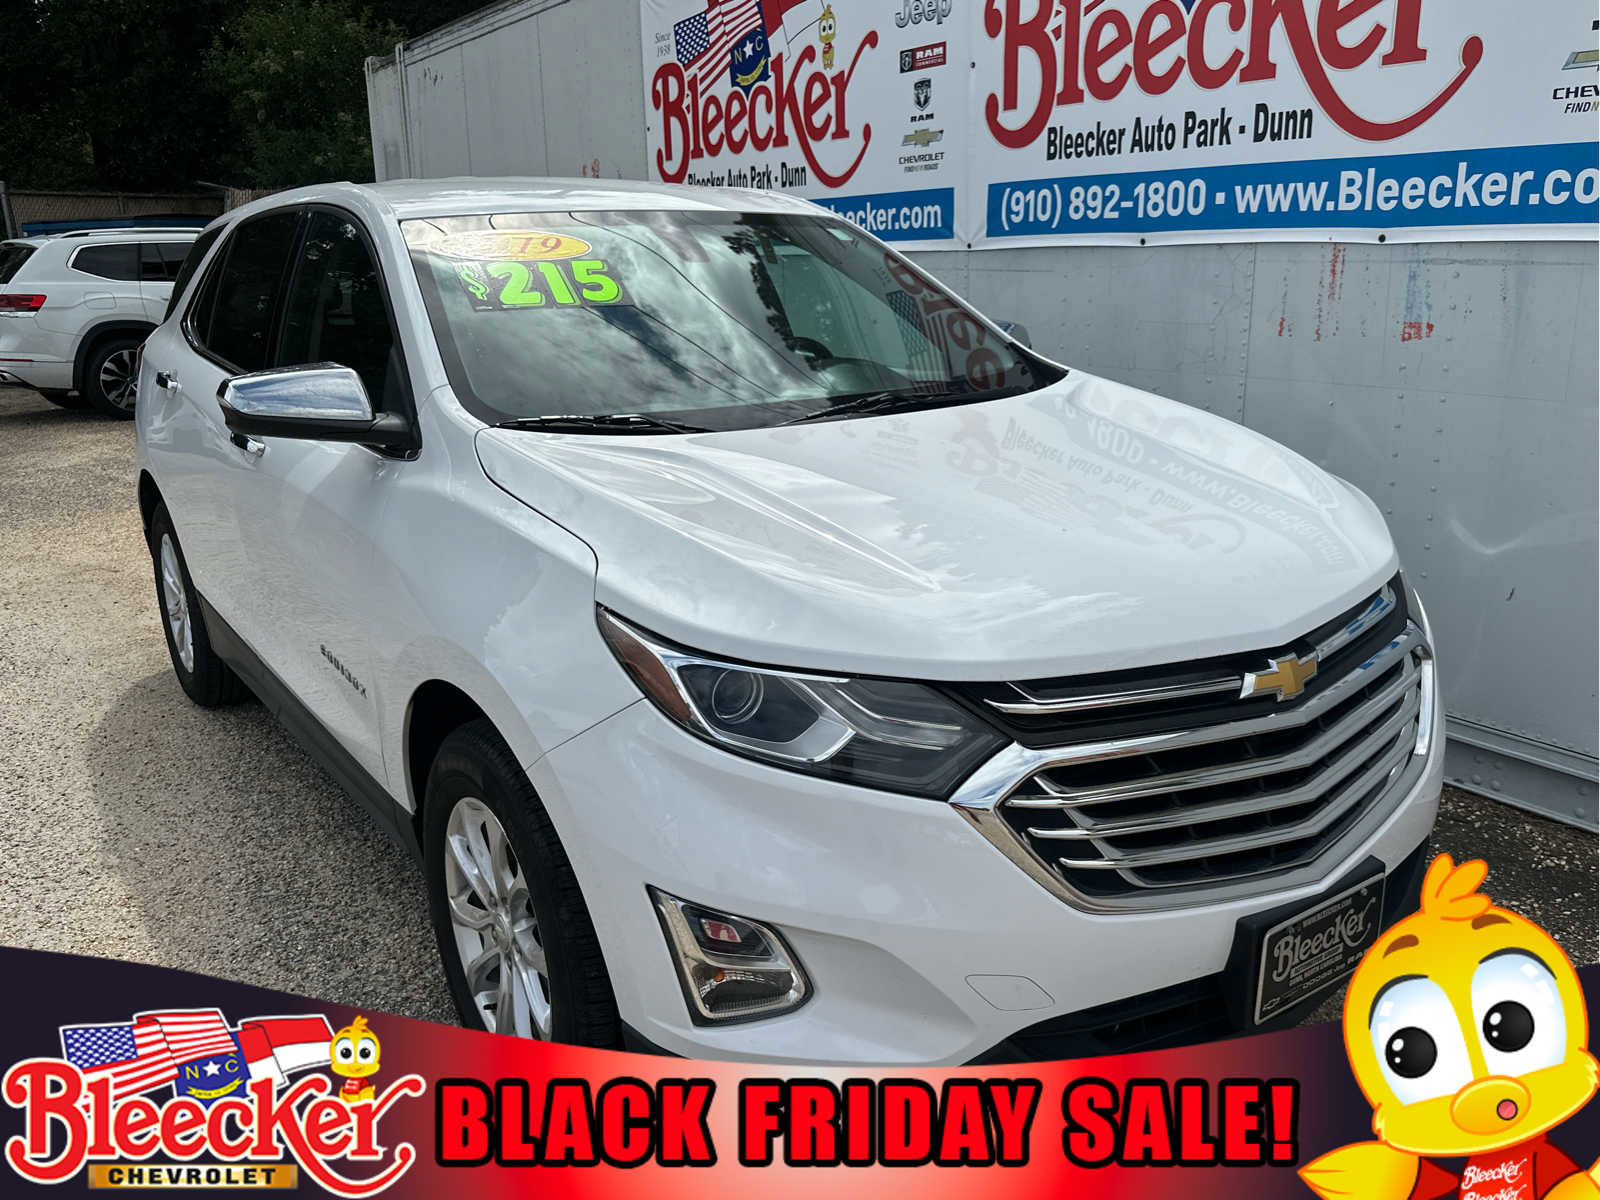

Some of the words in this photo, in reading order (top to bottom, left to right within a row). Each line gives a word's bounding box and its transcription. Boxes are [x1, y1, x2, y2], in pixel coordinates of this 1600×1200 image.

[895, 0, 953, 28] Jeep
[916, 47, 943, 59] RAM
[652, 30, 878, 188] Bleecker
[910, 113, 934, 122] RAM
[1046, 121, 1126, 161] Bleecker
[1130, 116, 1176, 153] Auto
[1182, 107, 1233, 149] Park
[1253, 103, 1313, 143] Dunn
[898, 152, 944, 164] CHEVROLET
[728, 168, 748, 188] Auto
[750, 164, 772, 189] Park
[781, 162, 807, 188] Dunn
[1001, 184, 1062, 231] (910)
[1068, 178, 1206, 221] 892-1800
[1234, 162, 1599, 214] www.Bleecker.co
[830, 202, 942, 231] ecker.com
[460, 260, 622, 306] $215
[1272, 897, 1376, 982] Bleecker
